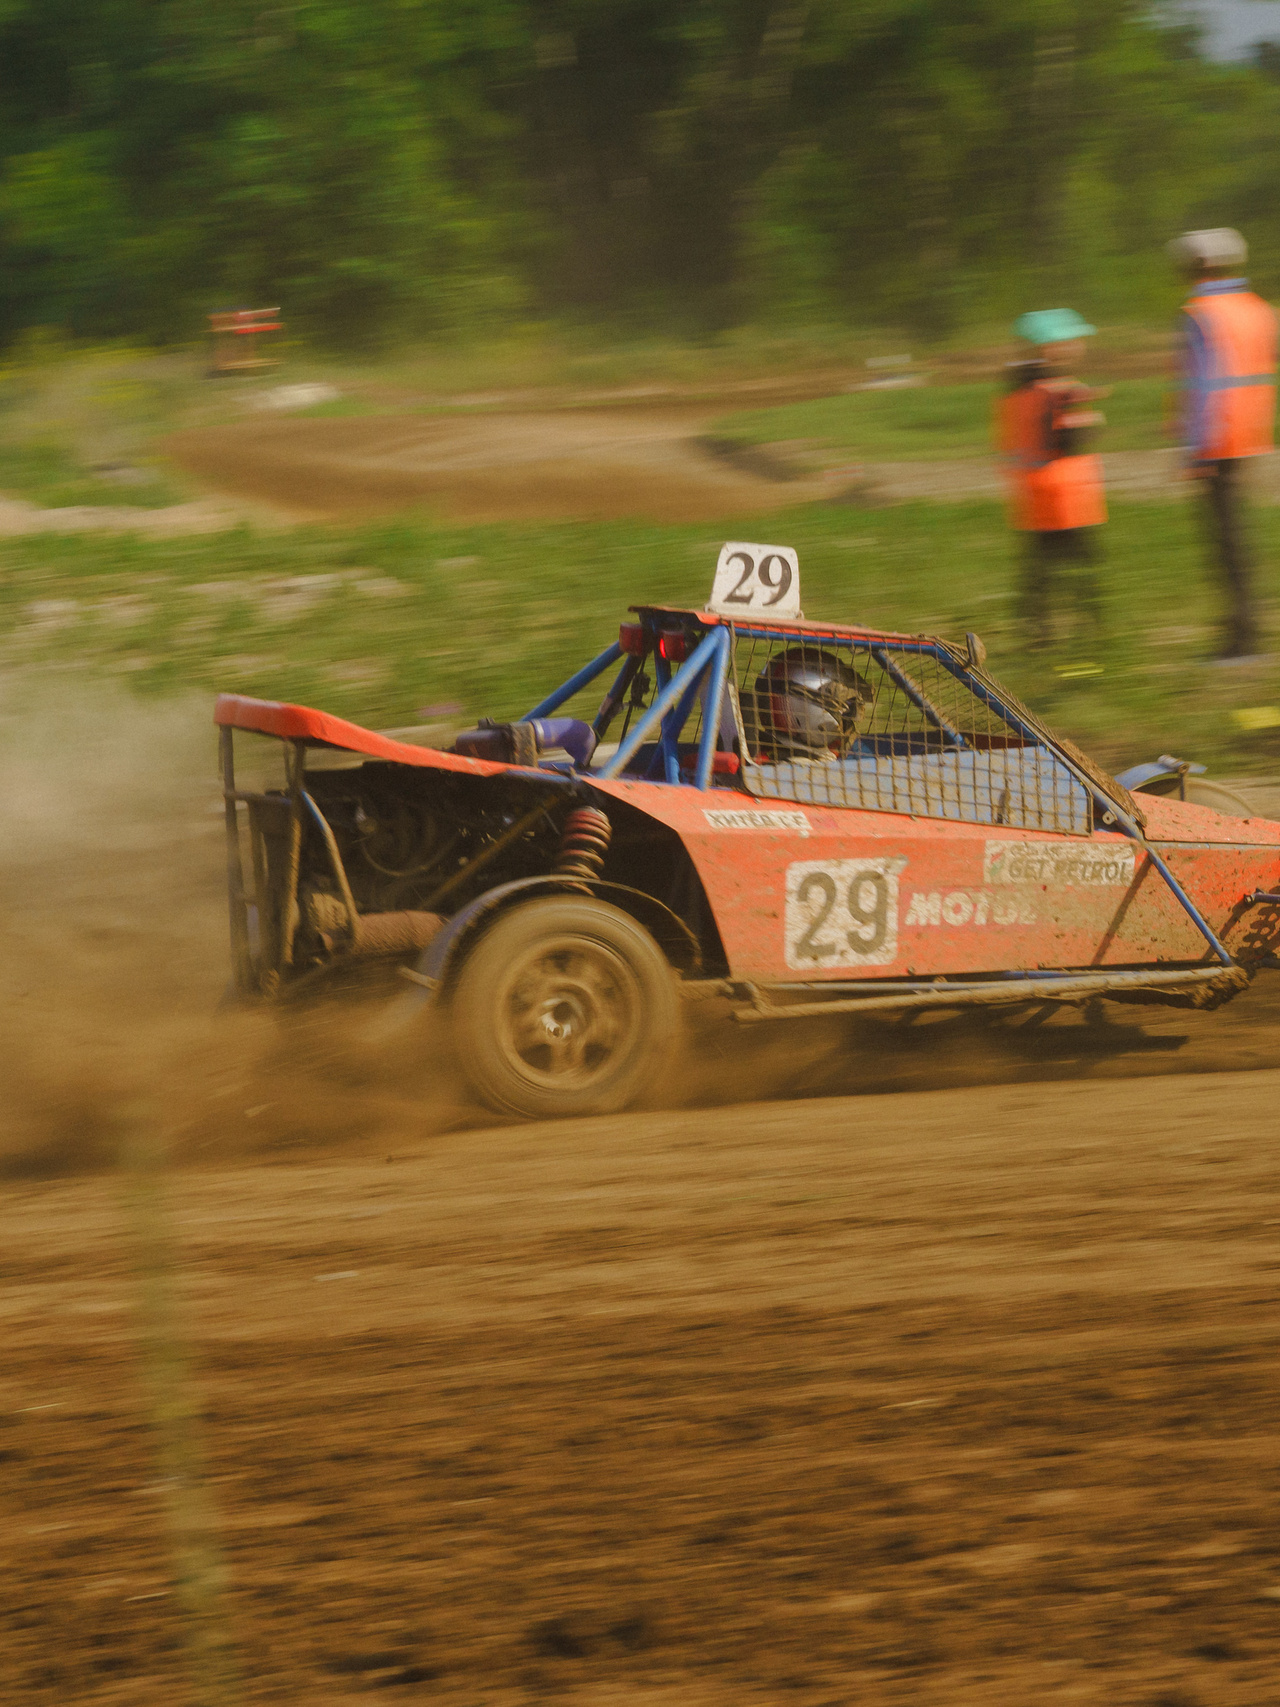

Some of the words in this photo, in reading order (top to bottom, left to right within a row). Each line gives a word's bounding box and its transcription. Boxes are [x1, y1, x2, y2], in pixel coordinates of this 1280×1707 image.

[723, 552, 792, 606] 29
[1009, 857, 1049, 880] GET
[796, 869, 888, 959] 29
